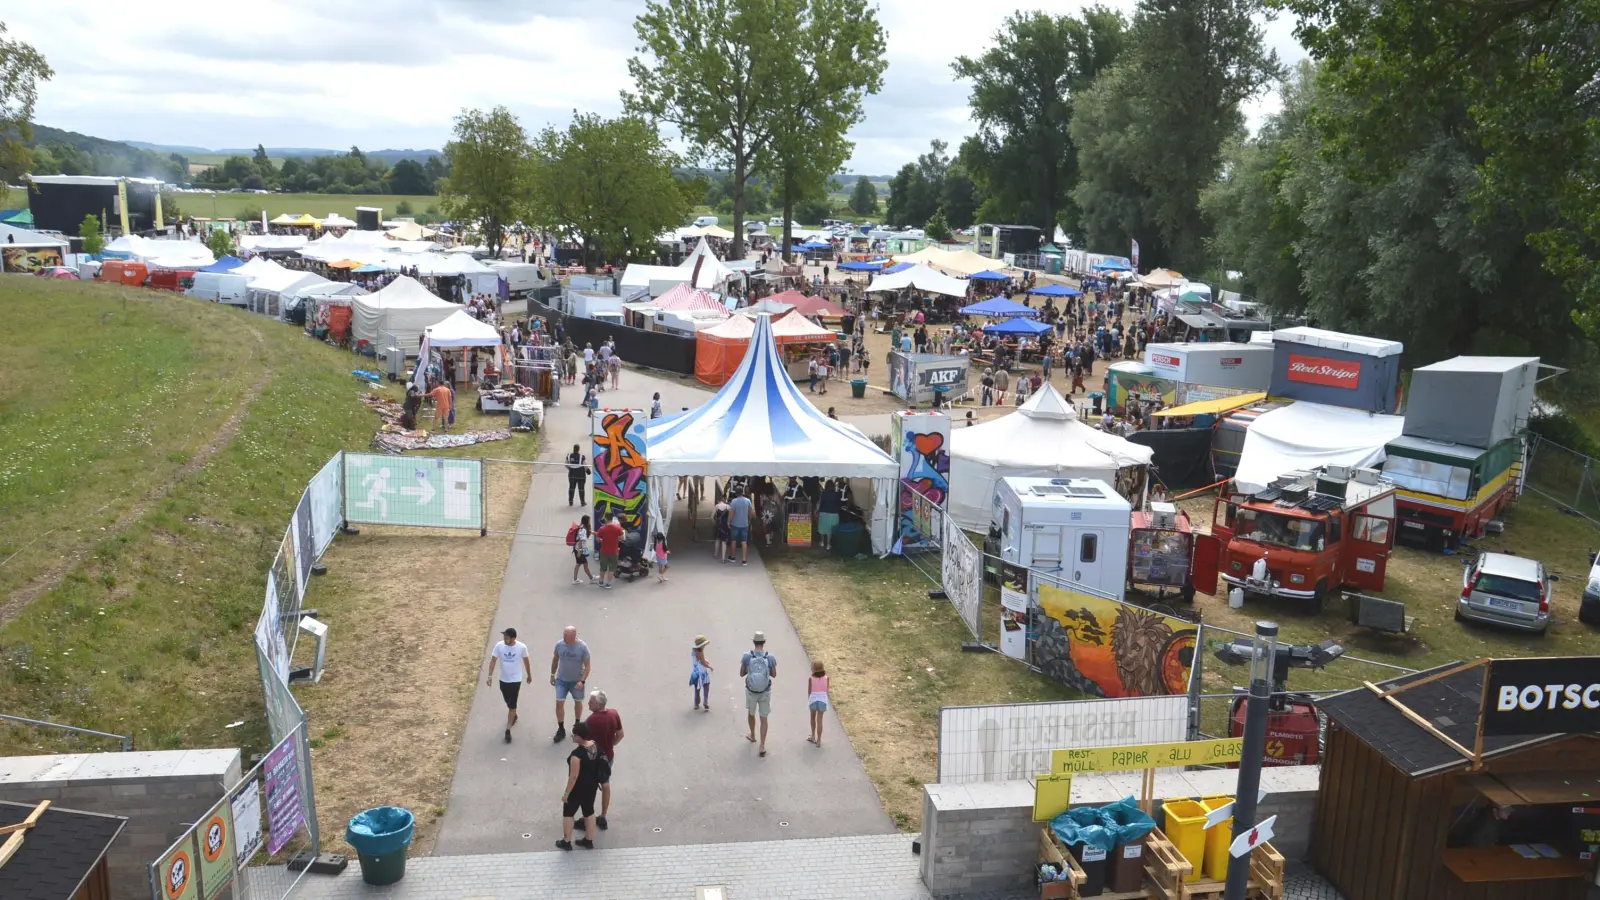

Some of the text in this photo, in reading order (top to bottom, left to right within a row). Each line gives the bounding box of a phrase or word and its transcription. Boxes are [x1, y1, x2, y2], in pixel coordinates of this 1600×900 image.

[929, 370, 958, 384] AKF
[1289, 362, 1359, 379] Red Stripe
[1497, 683, 1600, 711] BOTSC
